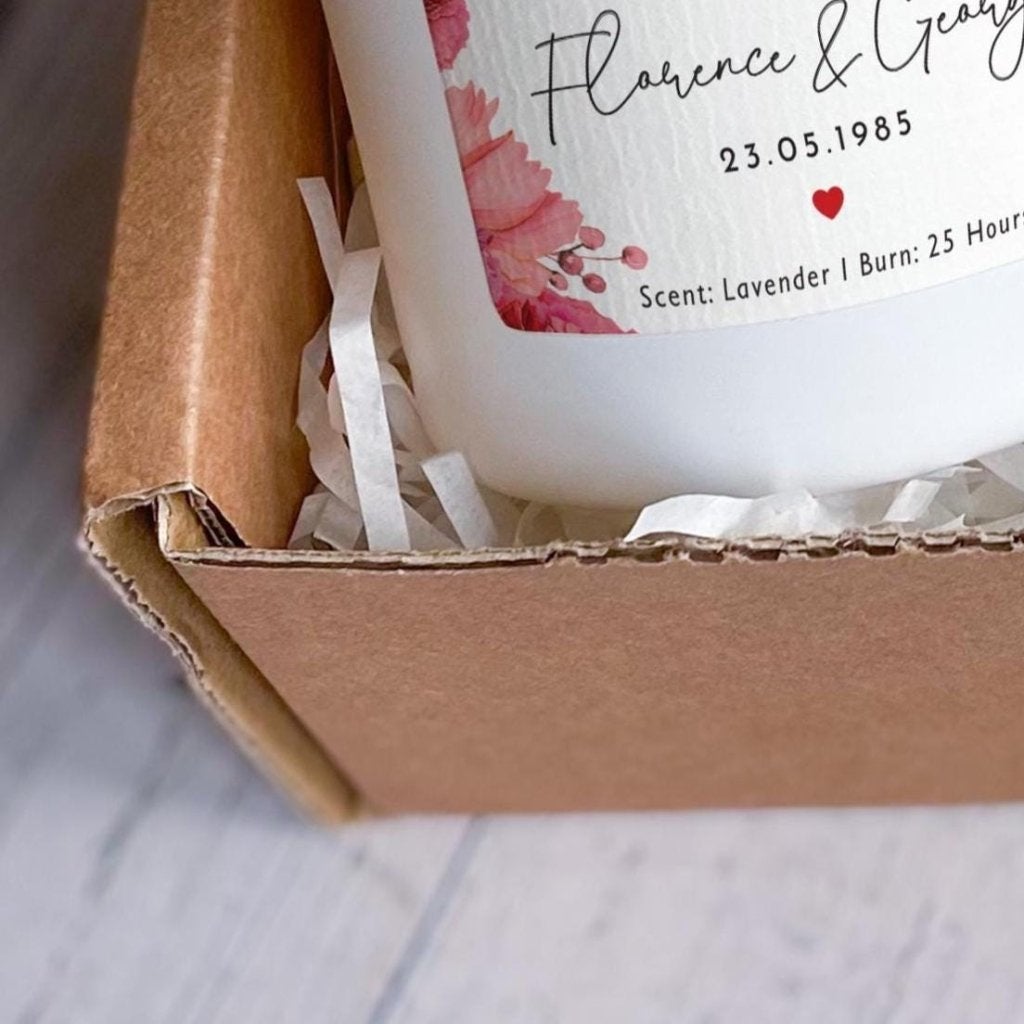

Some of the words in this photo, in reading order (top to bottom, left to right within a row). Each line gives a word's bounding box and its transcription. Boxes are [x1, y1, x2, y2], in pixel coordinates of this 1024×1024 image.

[531, 10, 796, 146] Florence
[720, 110, 912, 172] 23.05.1985
[639, 285, 713, 309] Scent:
[723, 264, 830, 301] Lavender
[859, 245, 918, 276] Burn:
[928, 228, 955, 259] 25
